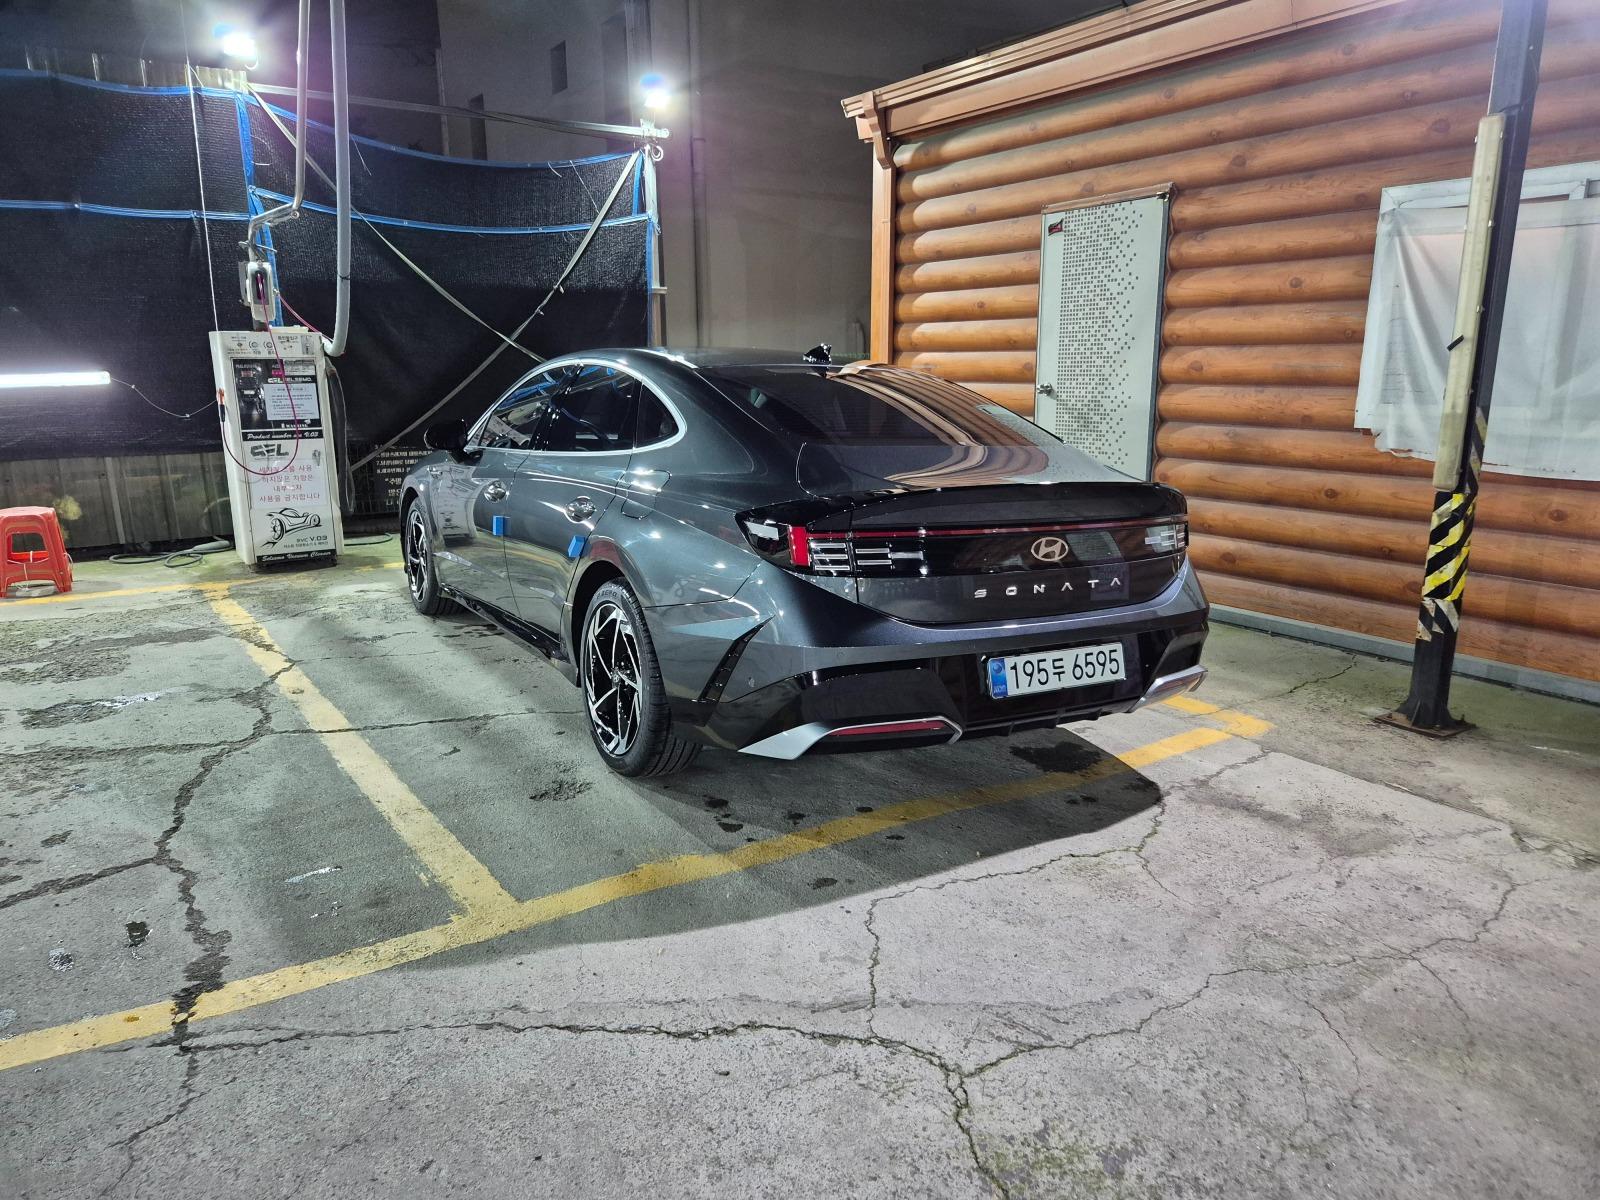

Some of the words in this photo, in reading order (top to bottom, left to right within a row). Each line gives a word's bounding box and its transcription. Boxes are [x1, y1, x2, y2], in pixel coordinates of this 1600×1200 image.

[285, 492, 320, 501] 금지합니다
[974, 577, 1121, 599] SONATA
[1010, 658, 1066, 689] 195두
[1072, 649, 1120, 681] 6595
